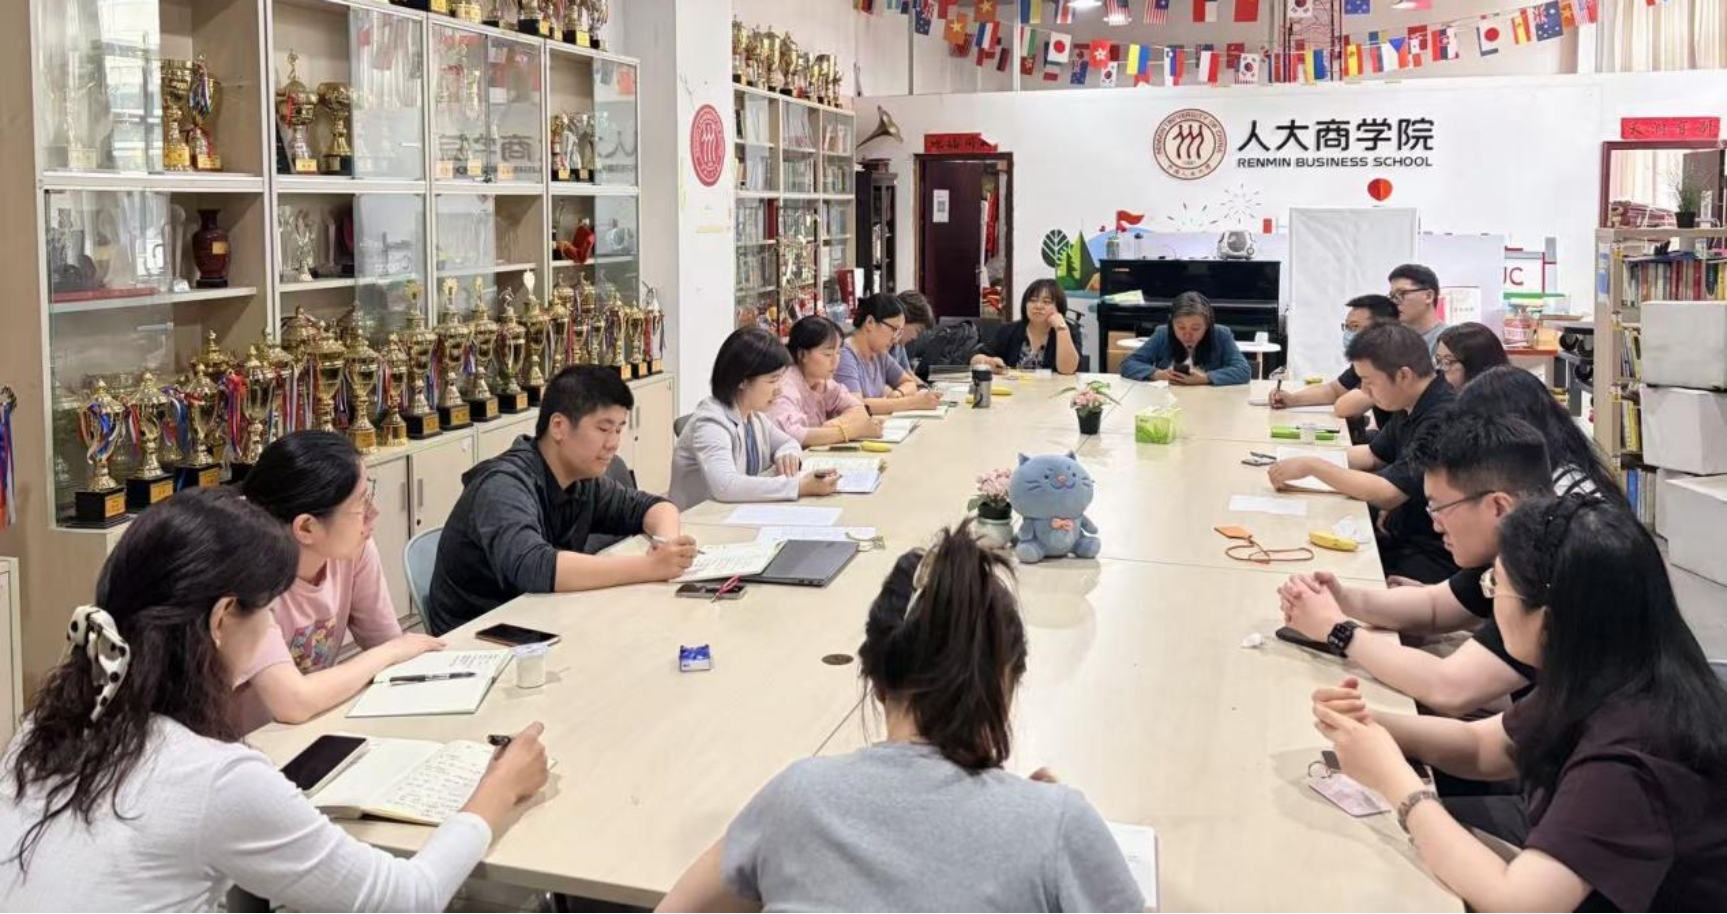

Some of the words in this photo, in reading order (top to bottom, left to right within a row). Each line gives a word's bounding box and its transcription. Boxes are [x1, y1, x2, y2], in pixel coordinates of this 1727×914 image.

[1237, 117, 1435, 151] 人大商学院
[1237, 157, 1291, 168] RENMIN
[1295, 156, 1369, 167] BUSINESS
[1372, 156, 1433, 167] SCHOOL
